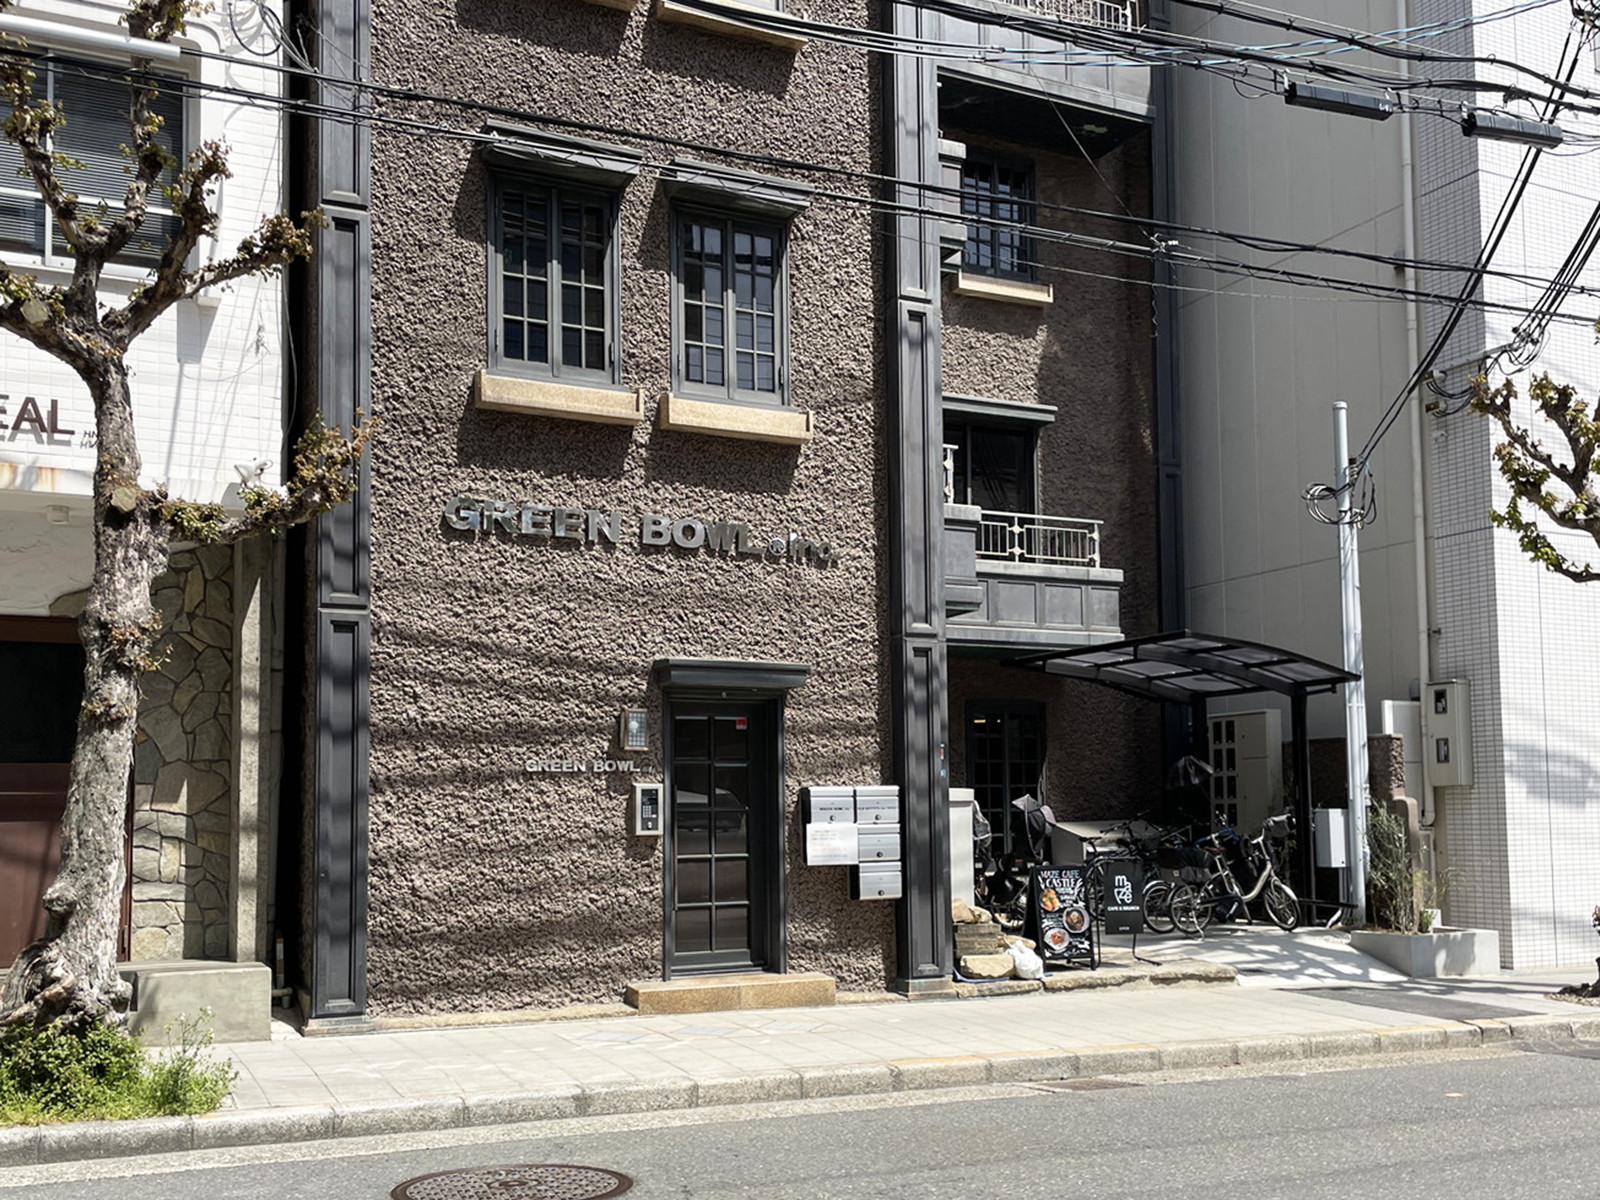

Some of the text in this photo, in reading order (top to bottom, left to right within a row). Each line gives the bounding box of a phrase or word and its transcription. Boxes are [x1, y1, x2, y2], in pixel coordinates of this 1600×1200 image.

[445, 497, 621, 543] GREEN
[642, 513, 768, 554] BOWL
[526, 760, 587, 772] GREEN
[594, 760, 640, 772] BOWL
